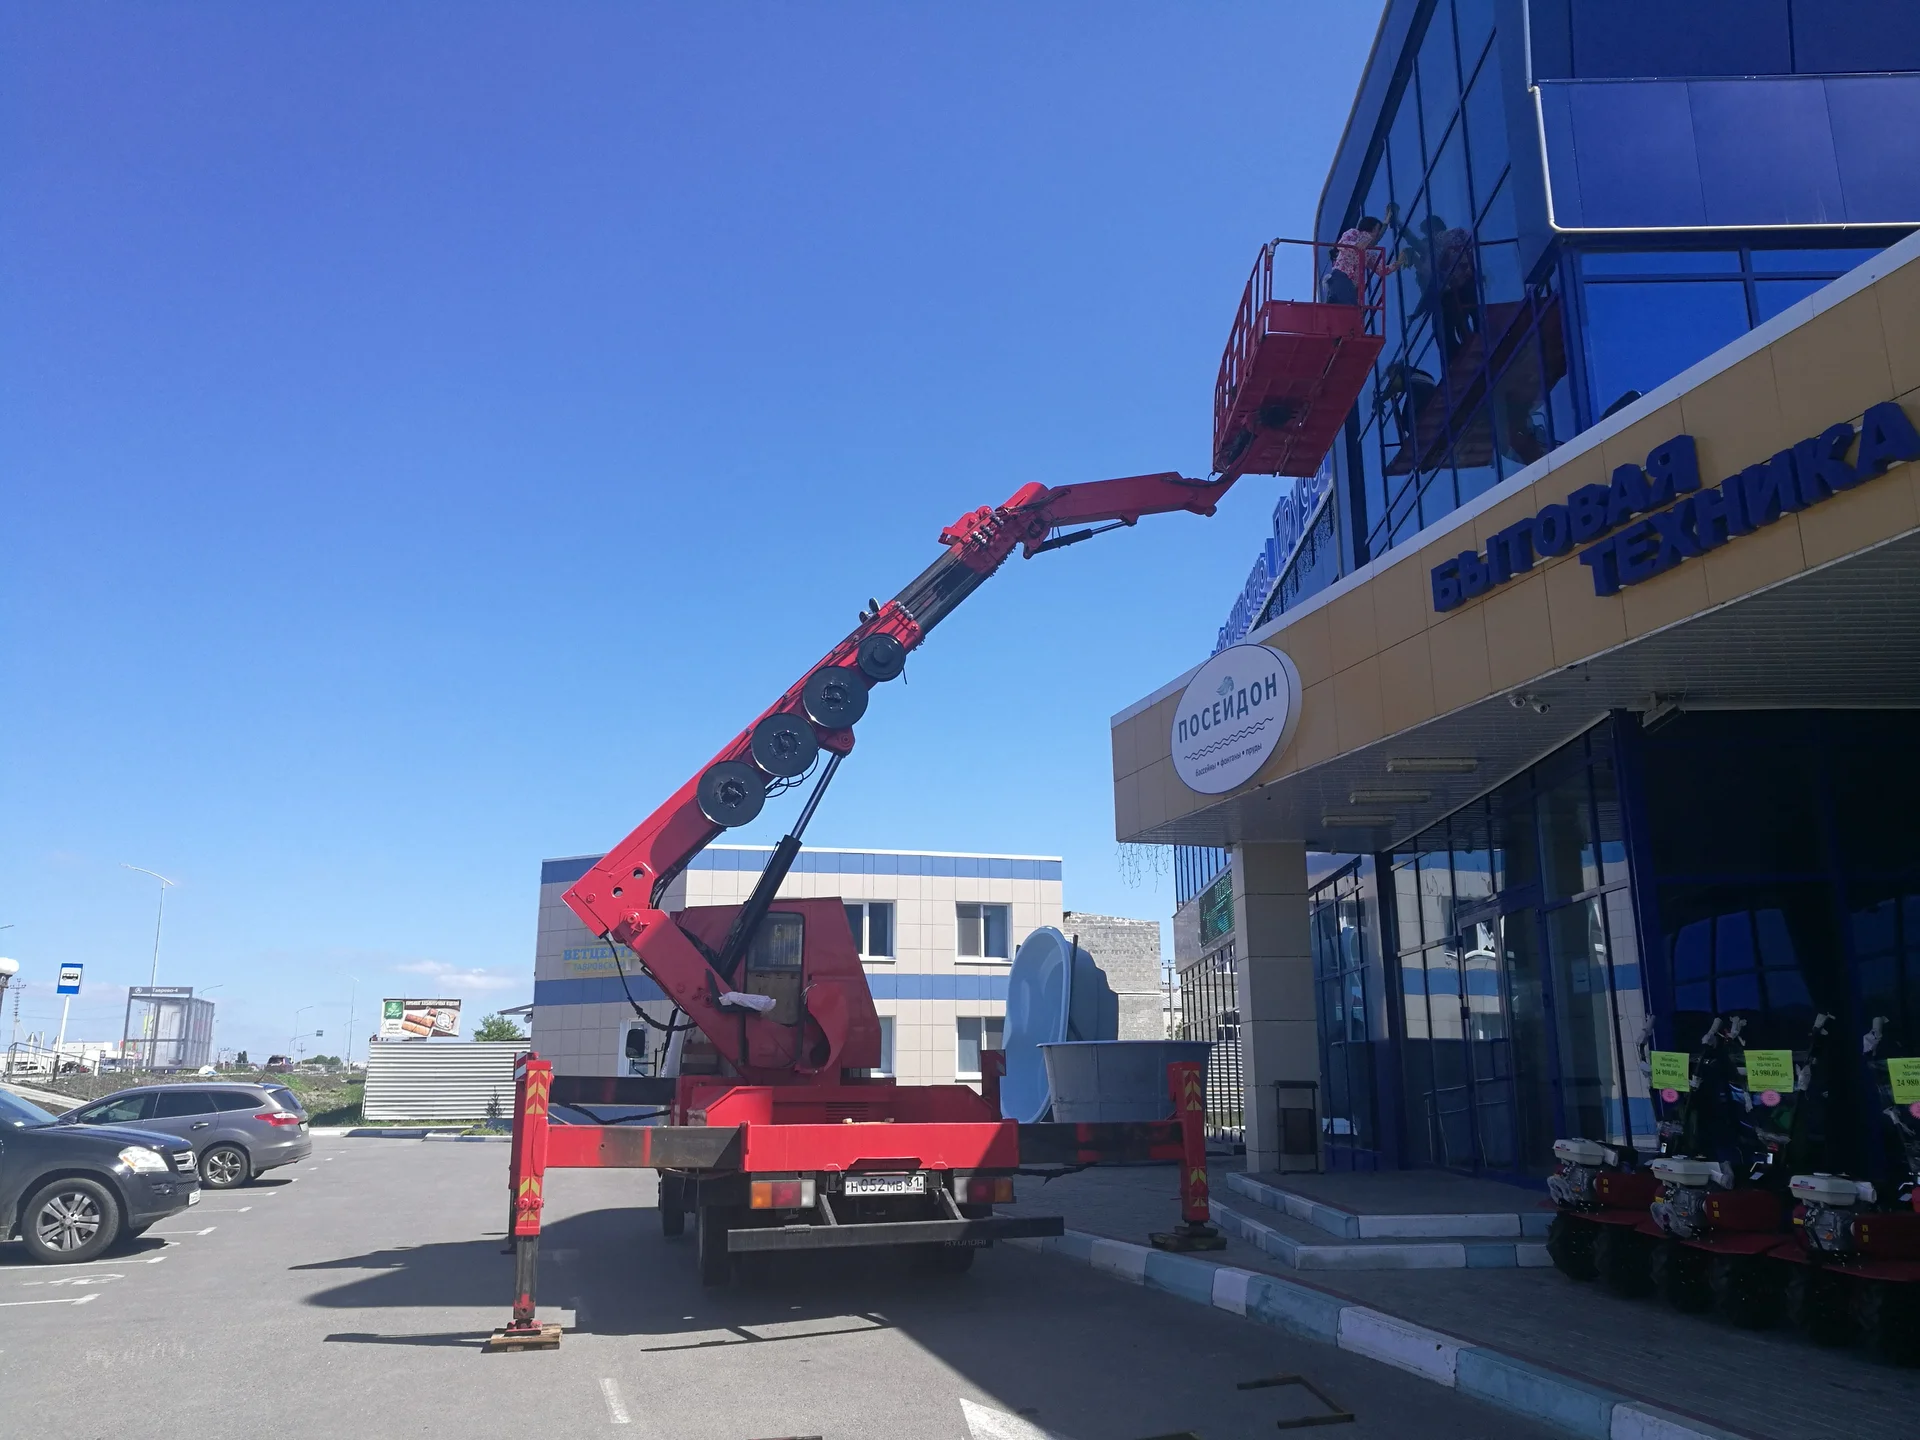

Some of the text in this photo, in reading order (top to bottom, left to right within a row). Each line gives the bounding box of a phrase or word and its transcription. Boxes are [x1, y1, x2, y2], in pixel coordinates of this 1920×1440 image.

[1580, 401, 1920, 597] ТЕХНИКА
[1431, 434, 1700, 613] БЫТОВАЯ
[1220, 751, 1242, 768] фонтаны
[1245, 743, 1262, 759] пруды
[1896, 1079, 1905, 1087] 24
[907, 1176, 920, 1188] 31
